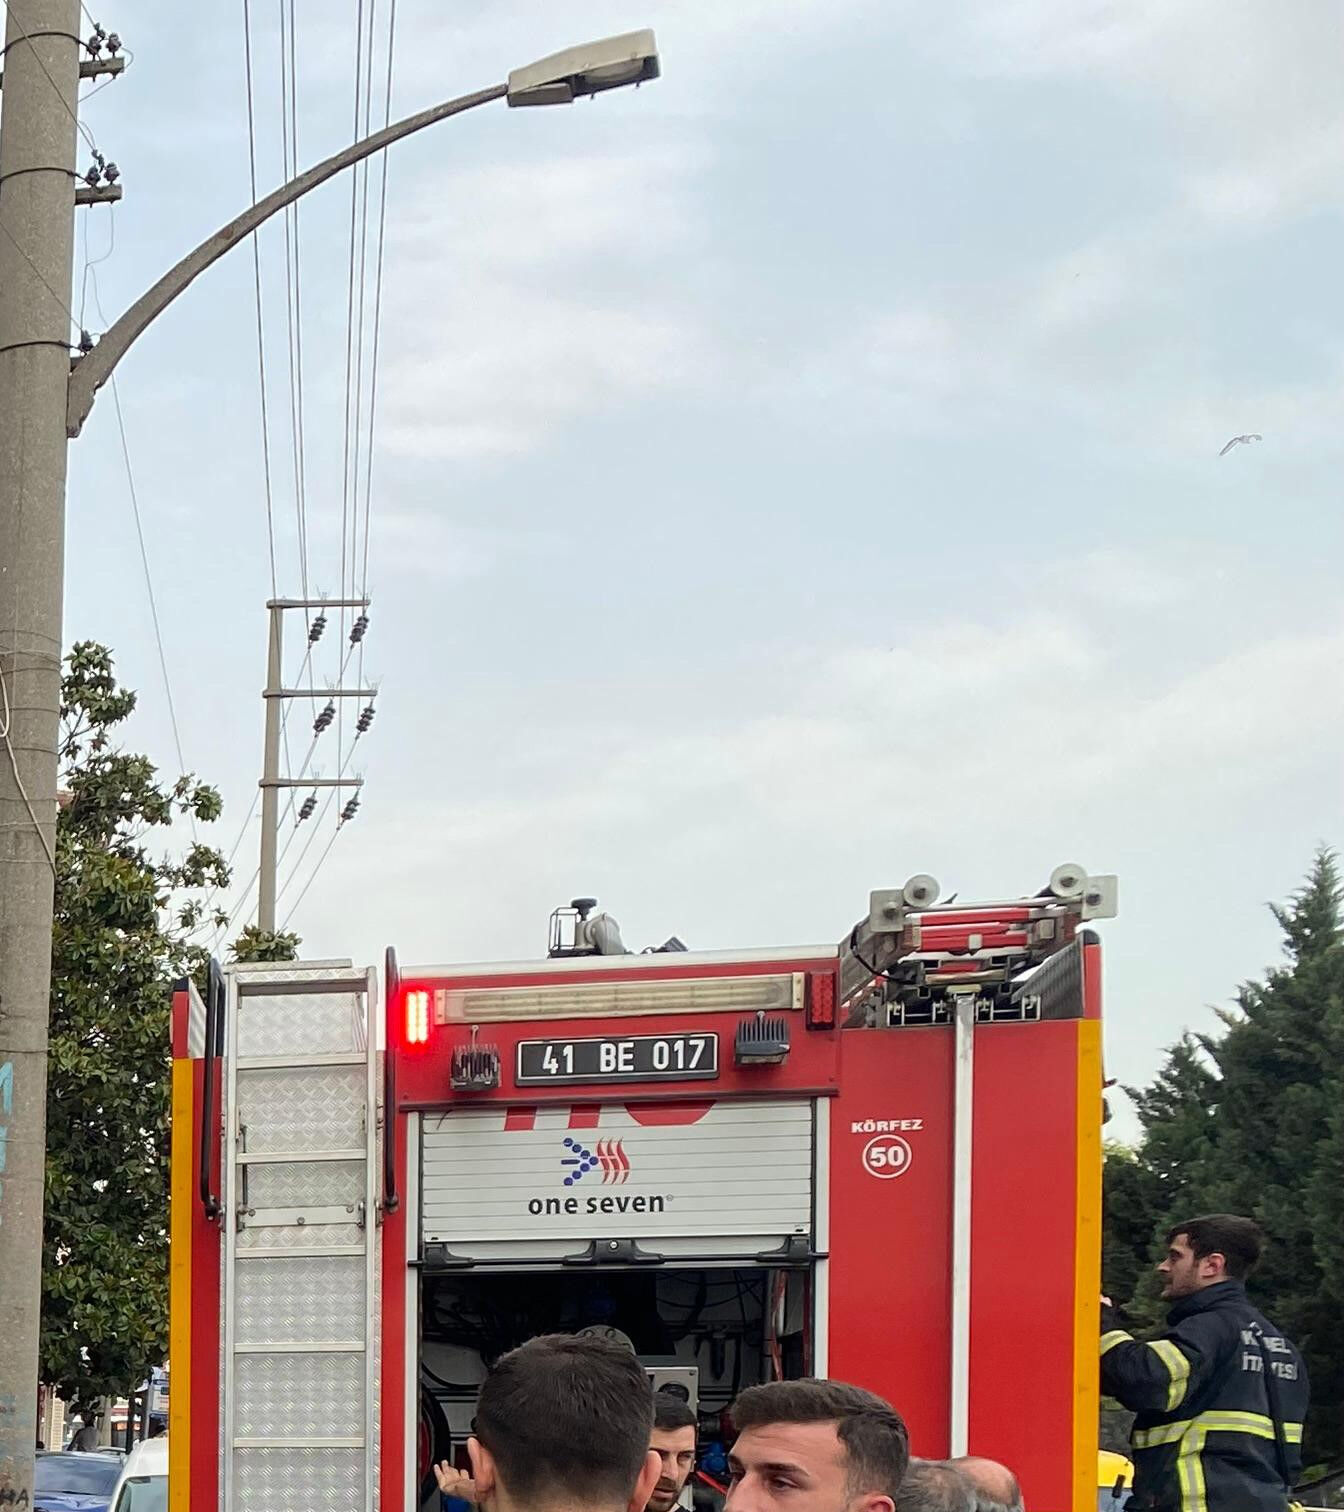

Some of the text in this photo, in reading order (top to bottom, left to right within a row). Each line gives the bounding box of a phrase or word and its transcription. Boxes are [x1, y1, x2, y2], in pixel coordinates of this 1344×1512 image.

[542, 1039, 706, 1075] 41 BE 017
[851, 1118, 924, 1134] KÖRFEZ
[869, 1145, 906, 1168] 50
[528, 1194, 665, 1215] one seven
